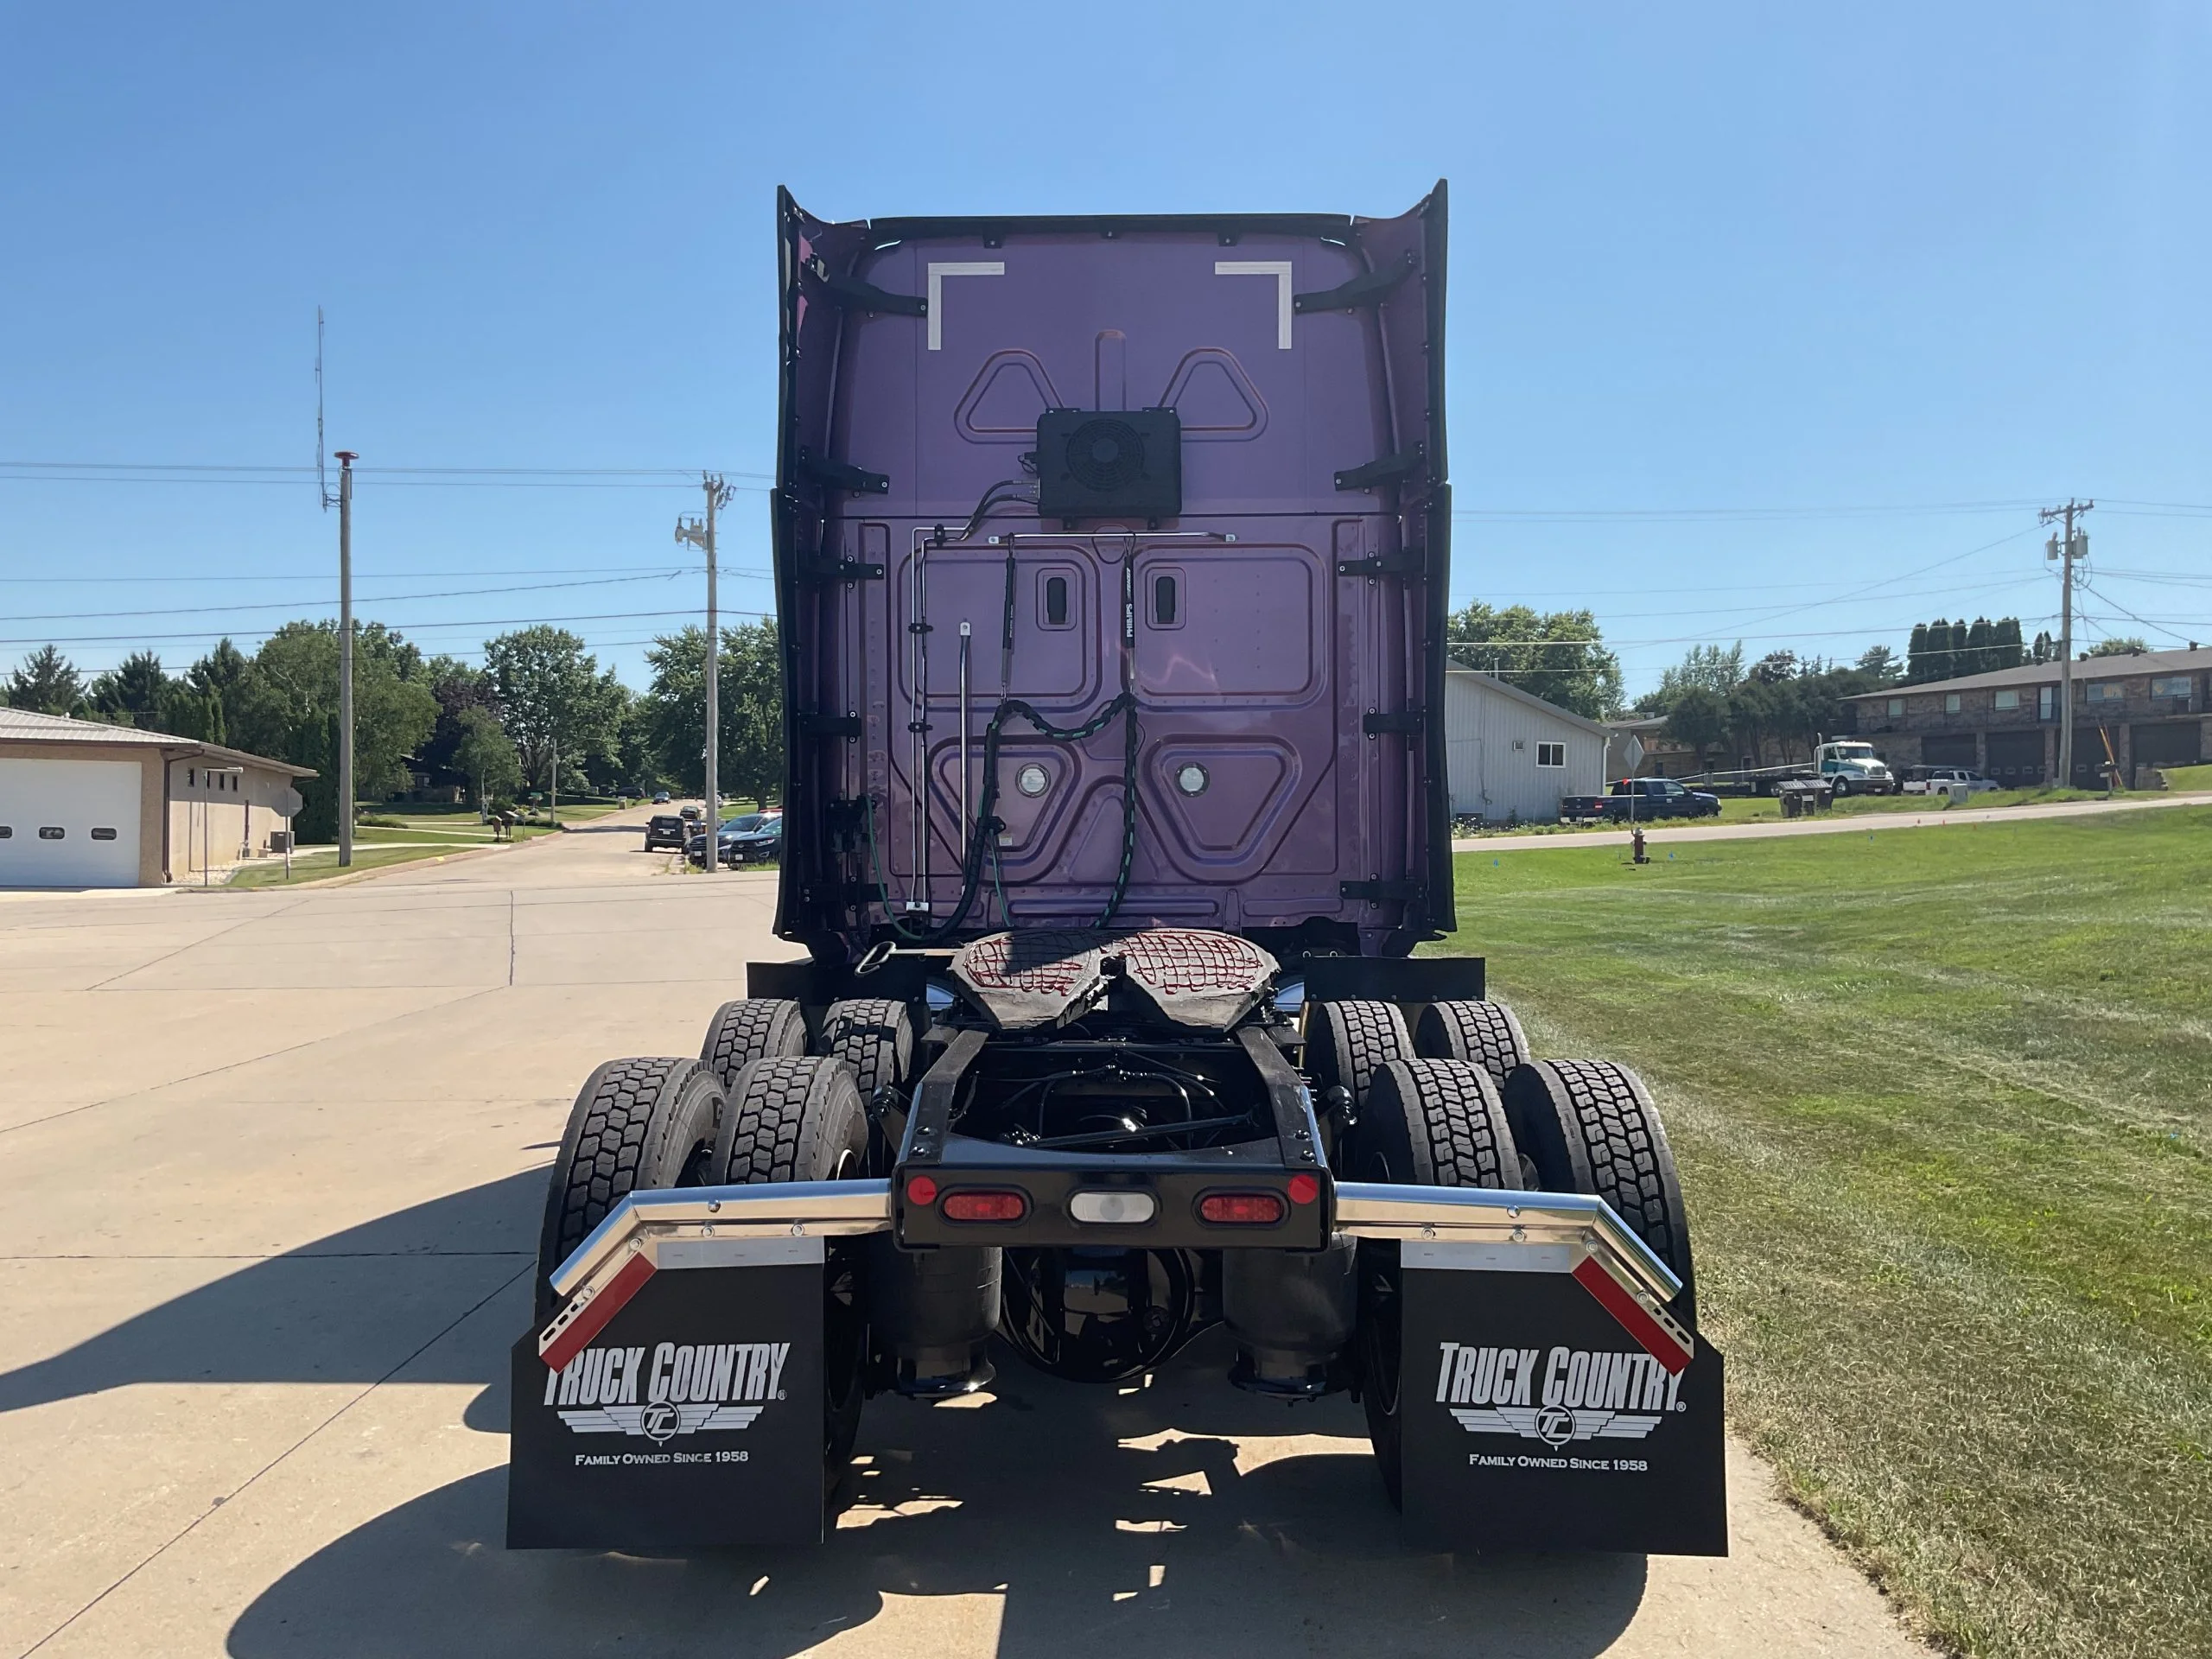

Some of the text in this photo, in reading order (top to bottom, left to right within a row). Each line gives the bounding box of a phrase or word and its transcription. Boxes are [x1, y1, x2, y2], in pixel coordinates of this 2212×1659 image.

[1435, 1342, 1540, 1406] TRUCK
[575, 1451, 749, 1465] FAMILY OWNED SINCE 1958
[1469, 1453, 1648, 1471] FAMILY OWNED SINCE 1958
